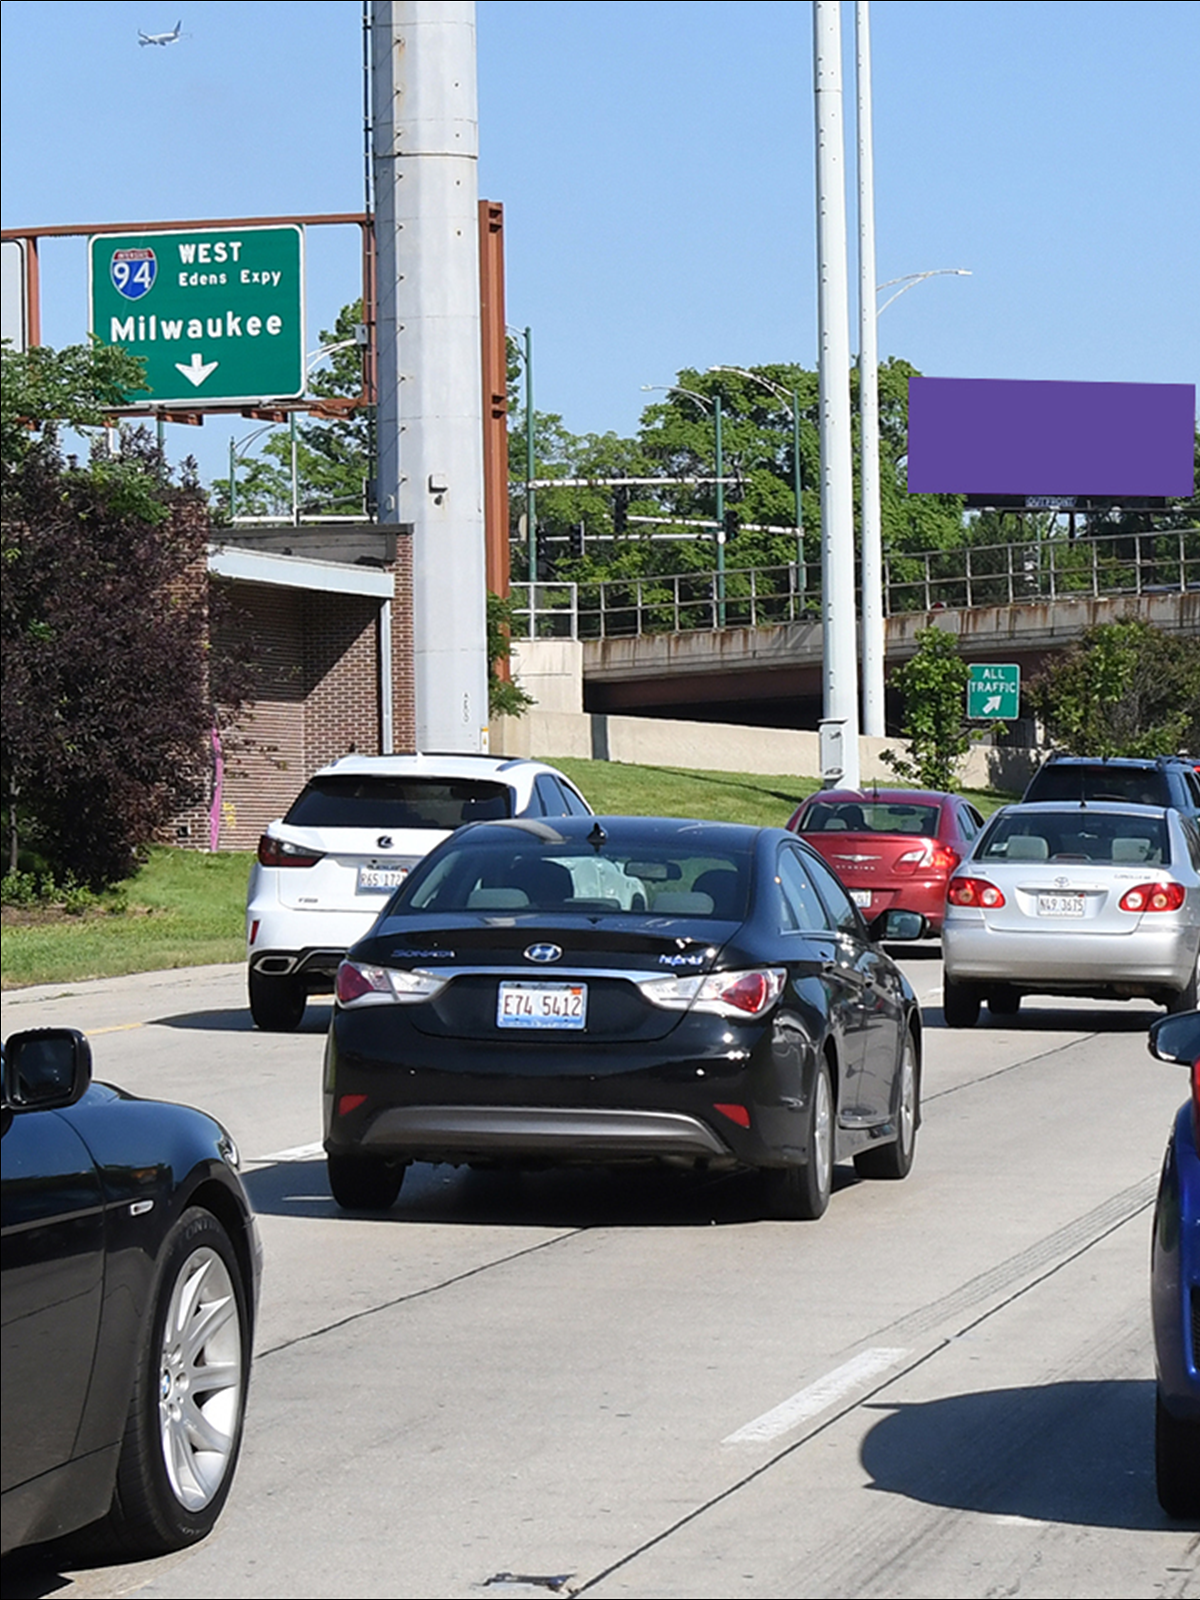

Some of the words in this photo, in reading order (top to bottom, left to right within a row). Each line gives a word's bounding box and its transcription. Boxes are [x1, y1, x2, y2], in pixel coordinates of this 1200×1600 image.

[178, 241, 242, 264] WEST
[113, 261, 152, 289] 94
[178, 272, 227, 287] Edens
[240, 269, 282, 287] Expy
[110, 311, 283, 342] Milwaukee
[982, 668, 1005, 680] ALL
[971, 681, 1016, 693] TRAFFIC
[360, 872, 379, 887] R65
[504, 994, 533, 1016] E74
[542, 995, 582, 1017] 5412
